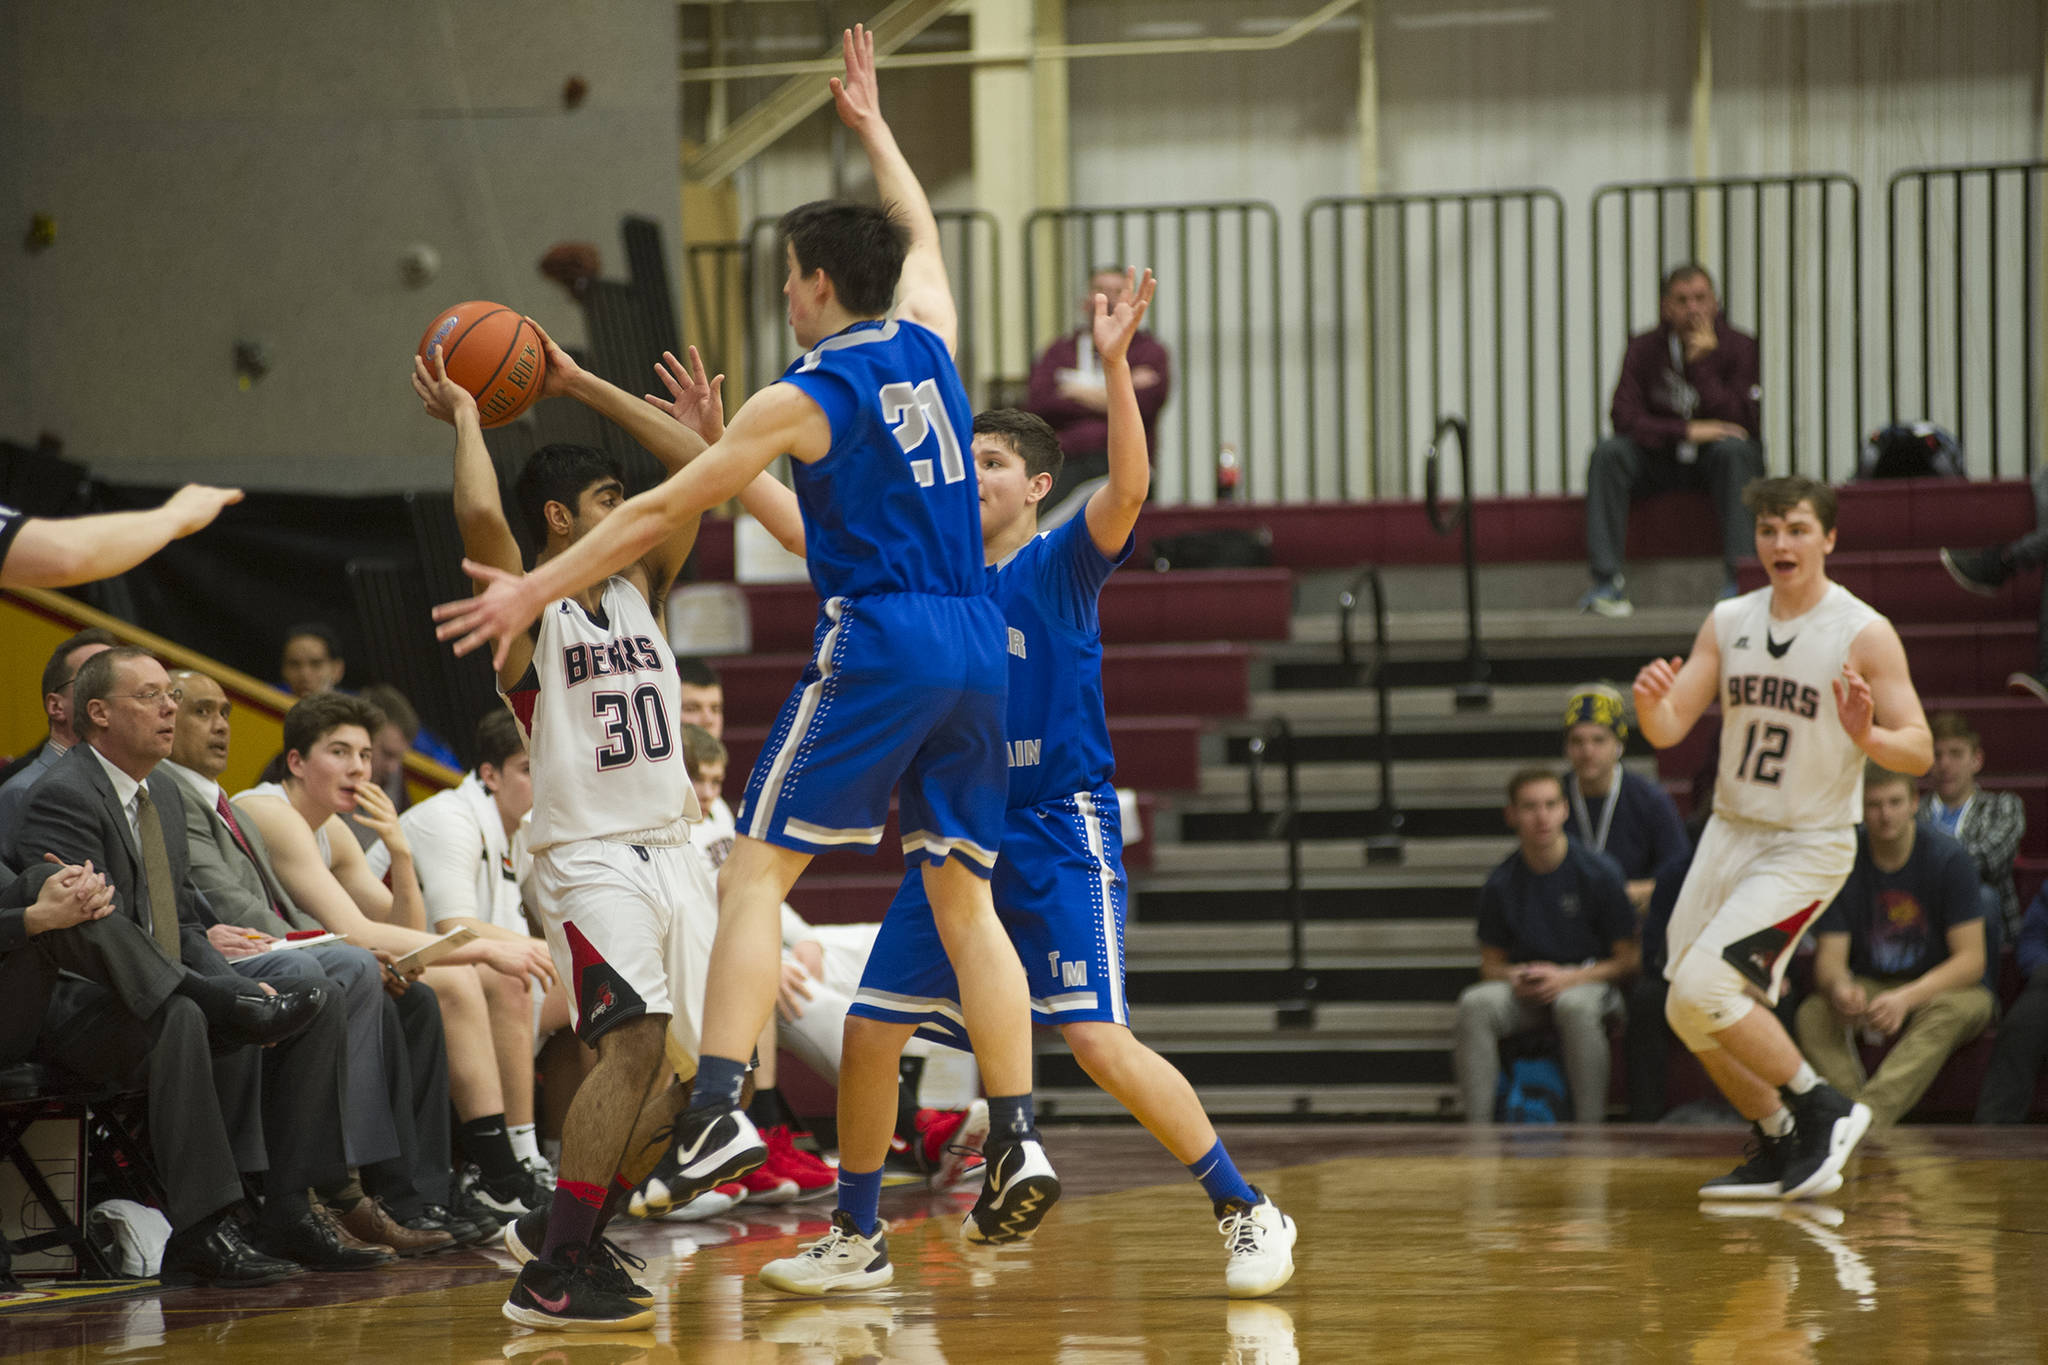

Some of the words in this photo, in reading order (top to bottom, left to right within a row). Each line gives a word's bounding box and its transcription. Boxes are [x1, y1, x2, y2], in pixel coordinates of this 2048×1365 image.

[481, 388, 516, 418] THE
[507, 344, 537, 390] ROCK
[879, 377, 966, 488] 21
[563, 634, 664, 688] BEARS
[592, 682, 674, 782] 30
[1727, 674, 1820, 721] BEARS
[1735, 719, 1793, 790] 12
[1048, 950, 1088, 988] TM
